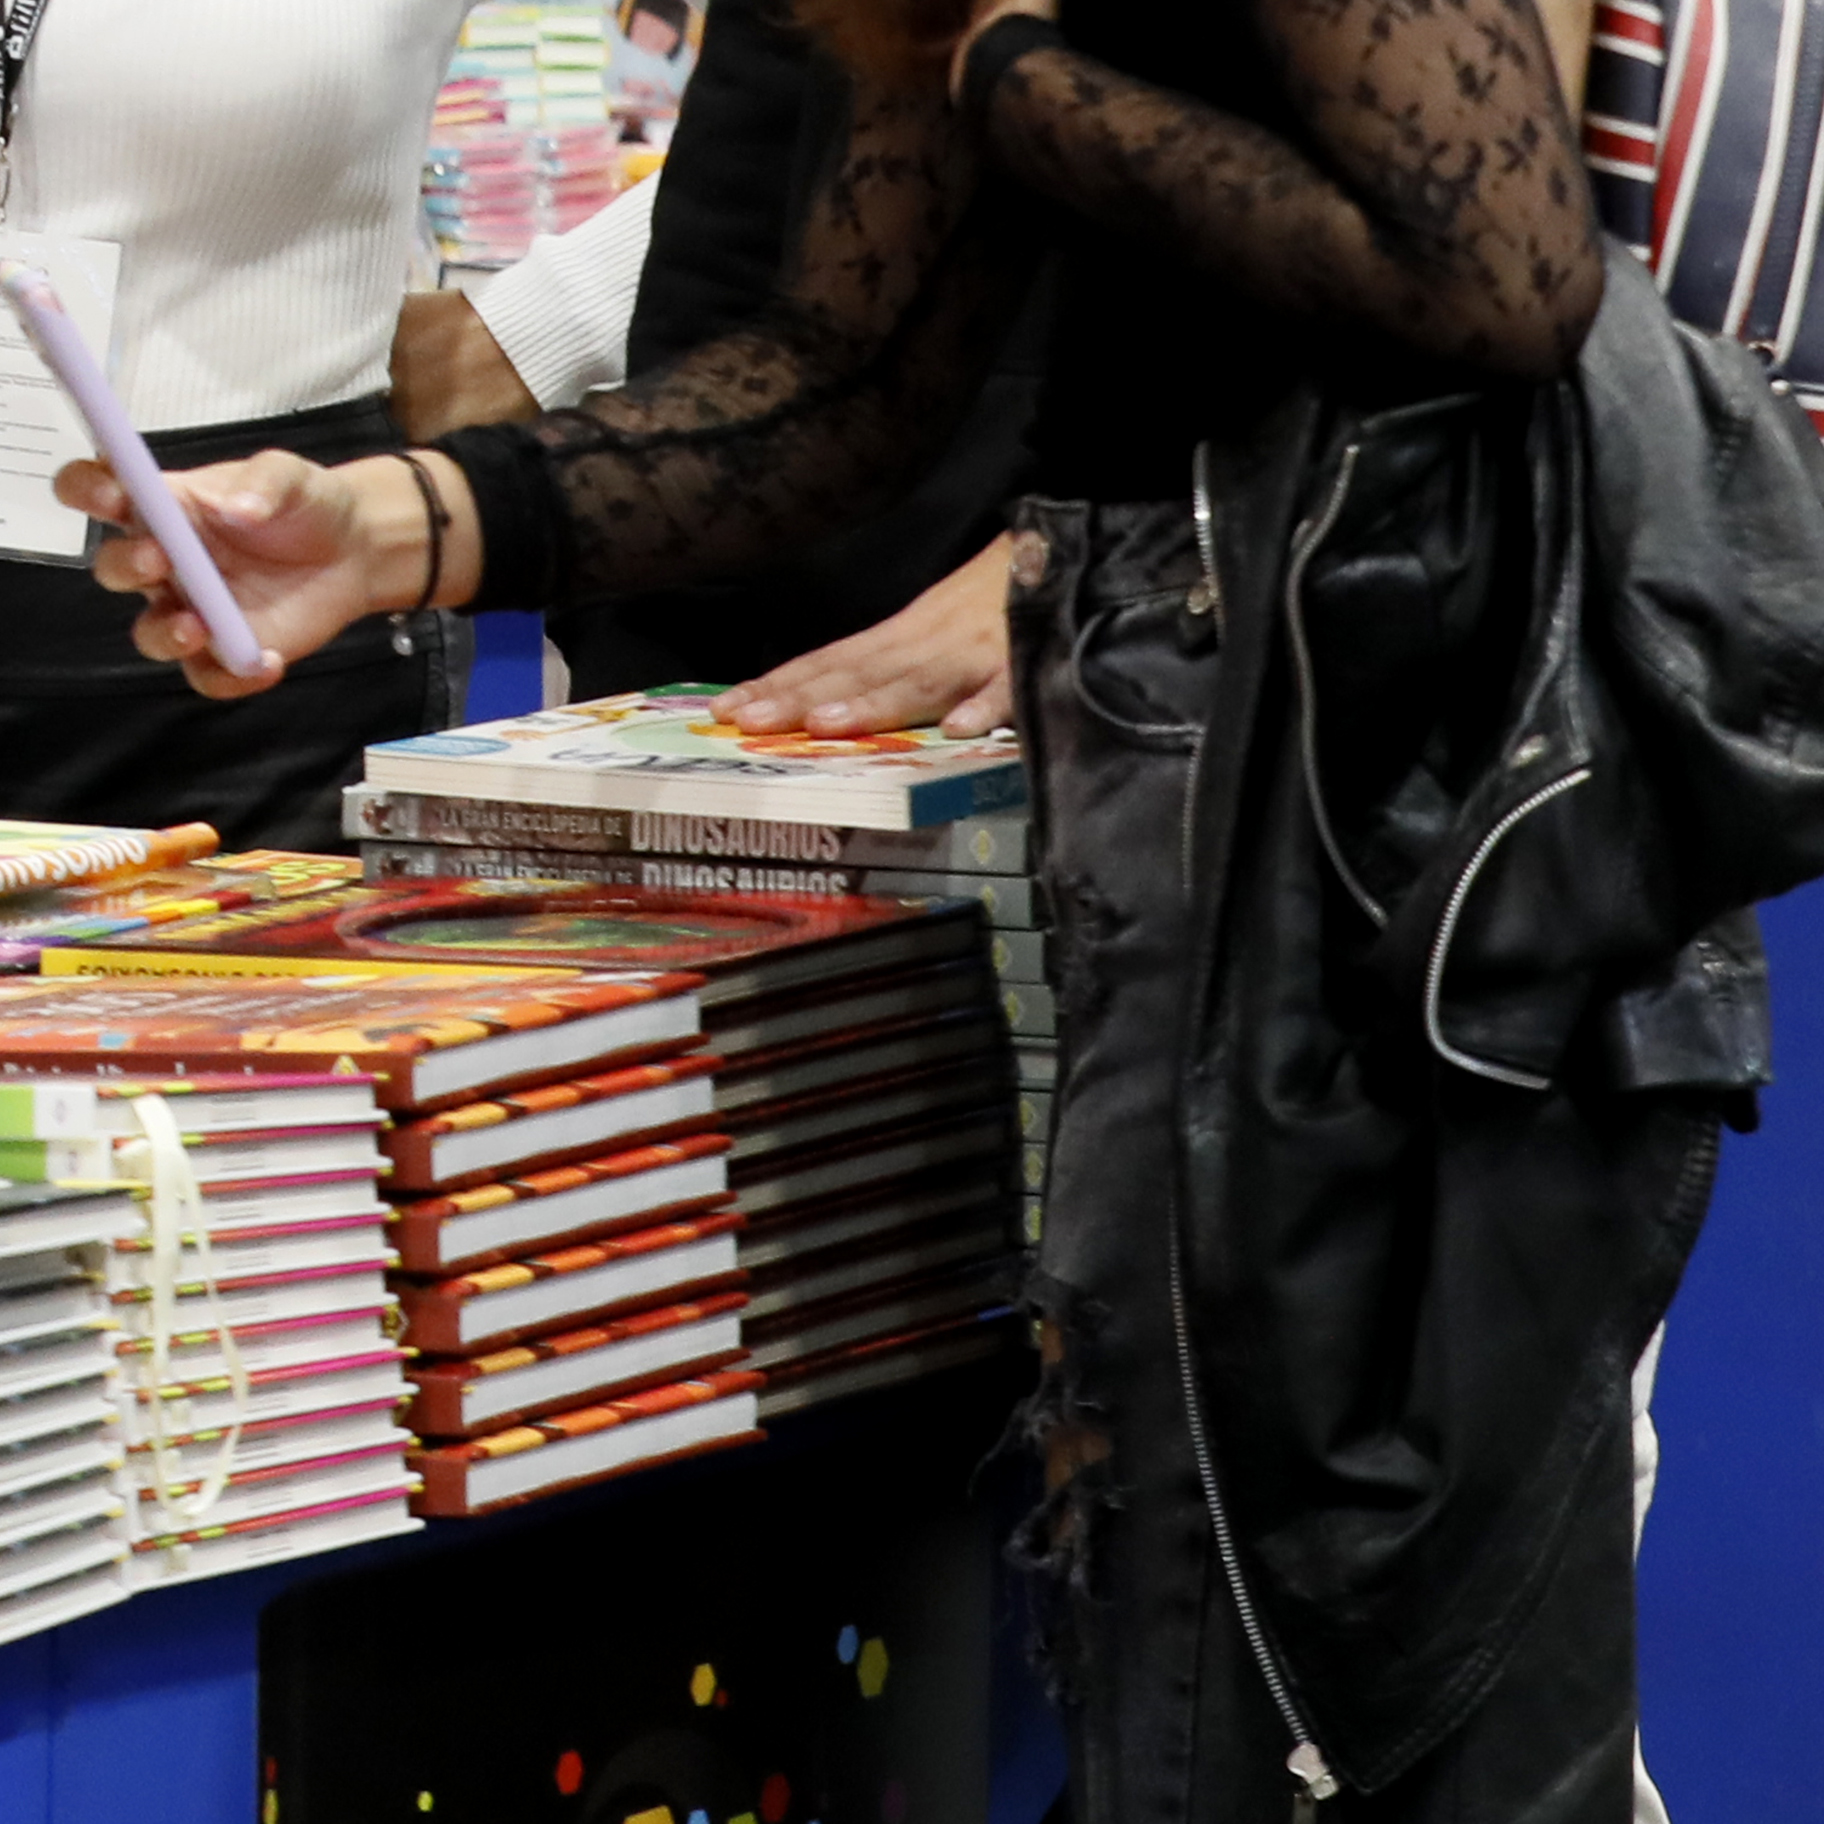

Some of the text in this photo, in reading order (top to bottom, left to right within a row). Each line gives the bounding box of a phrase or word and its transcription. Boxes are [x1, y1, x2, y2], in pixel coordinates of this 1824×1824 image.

[461, 808, 498, 832] GRAN
[500, 810, 599, 837] ENCICLOPEDIA
[602, 816, 624, 838] DE
[630, 809, 843, 862] DINOSAURIOS
